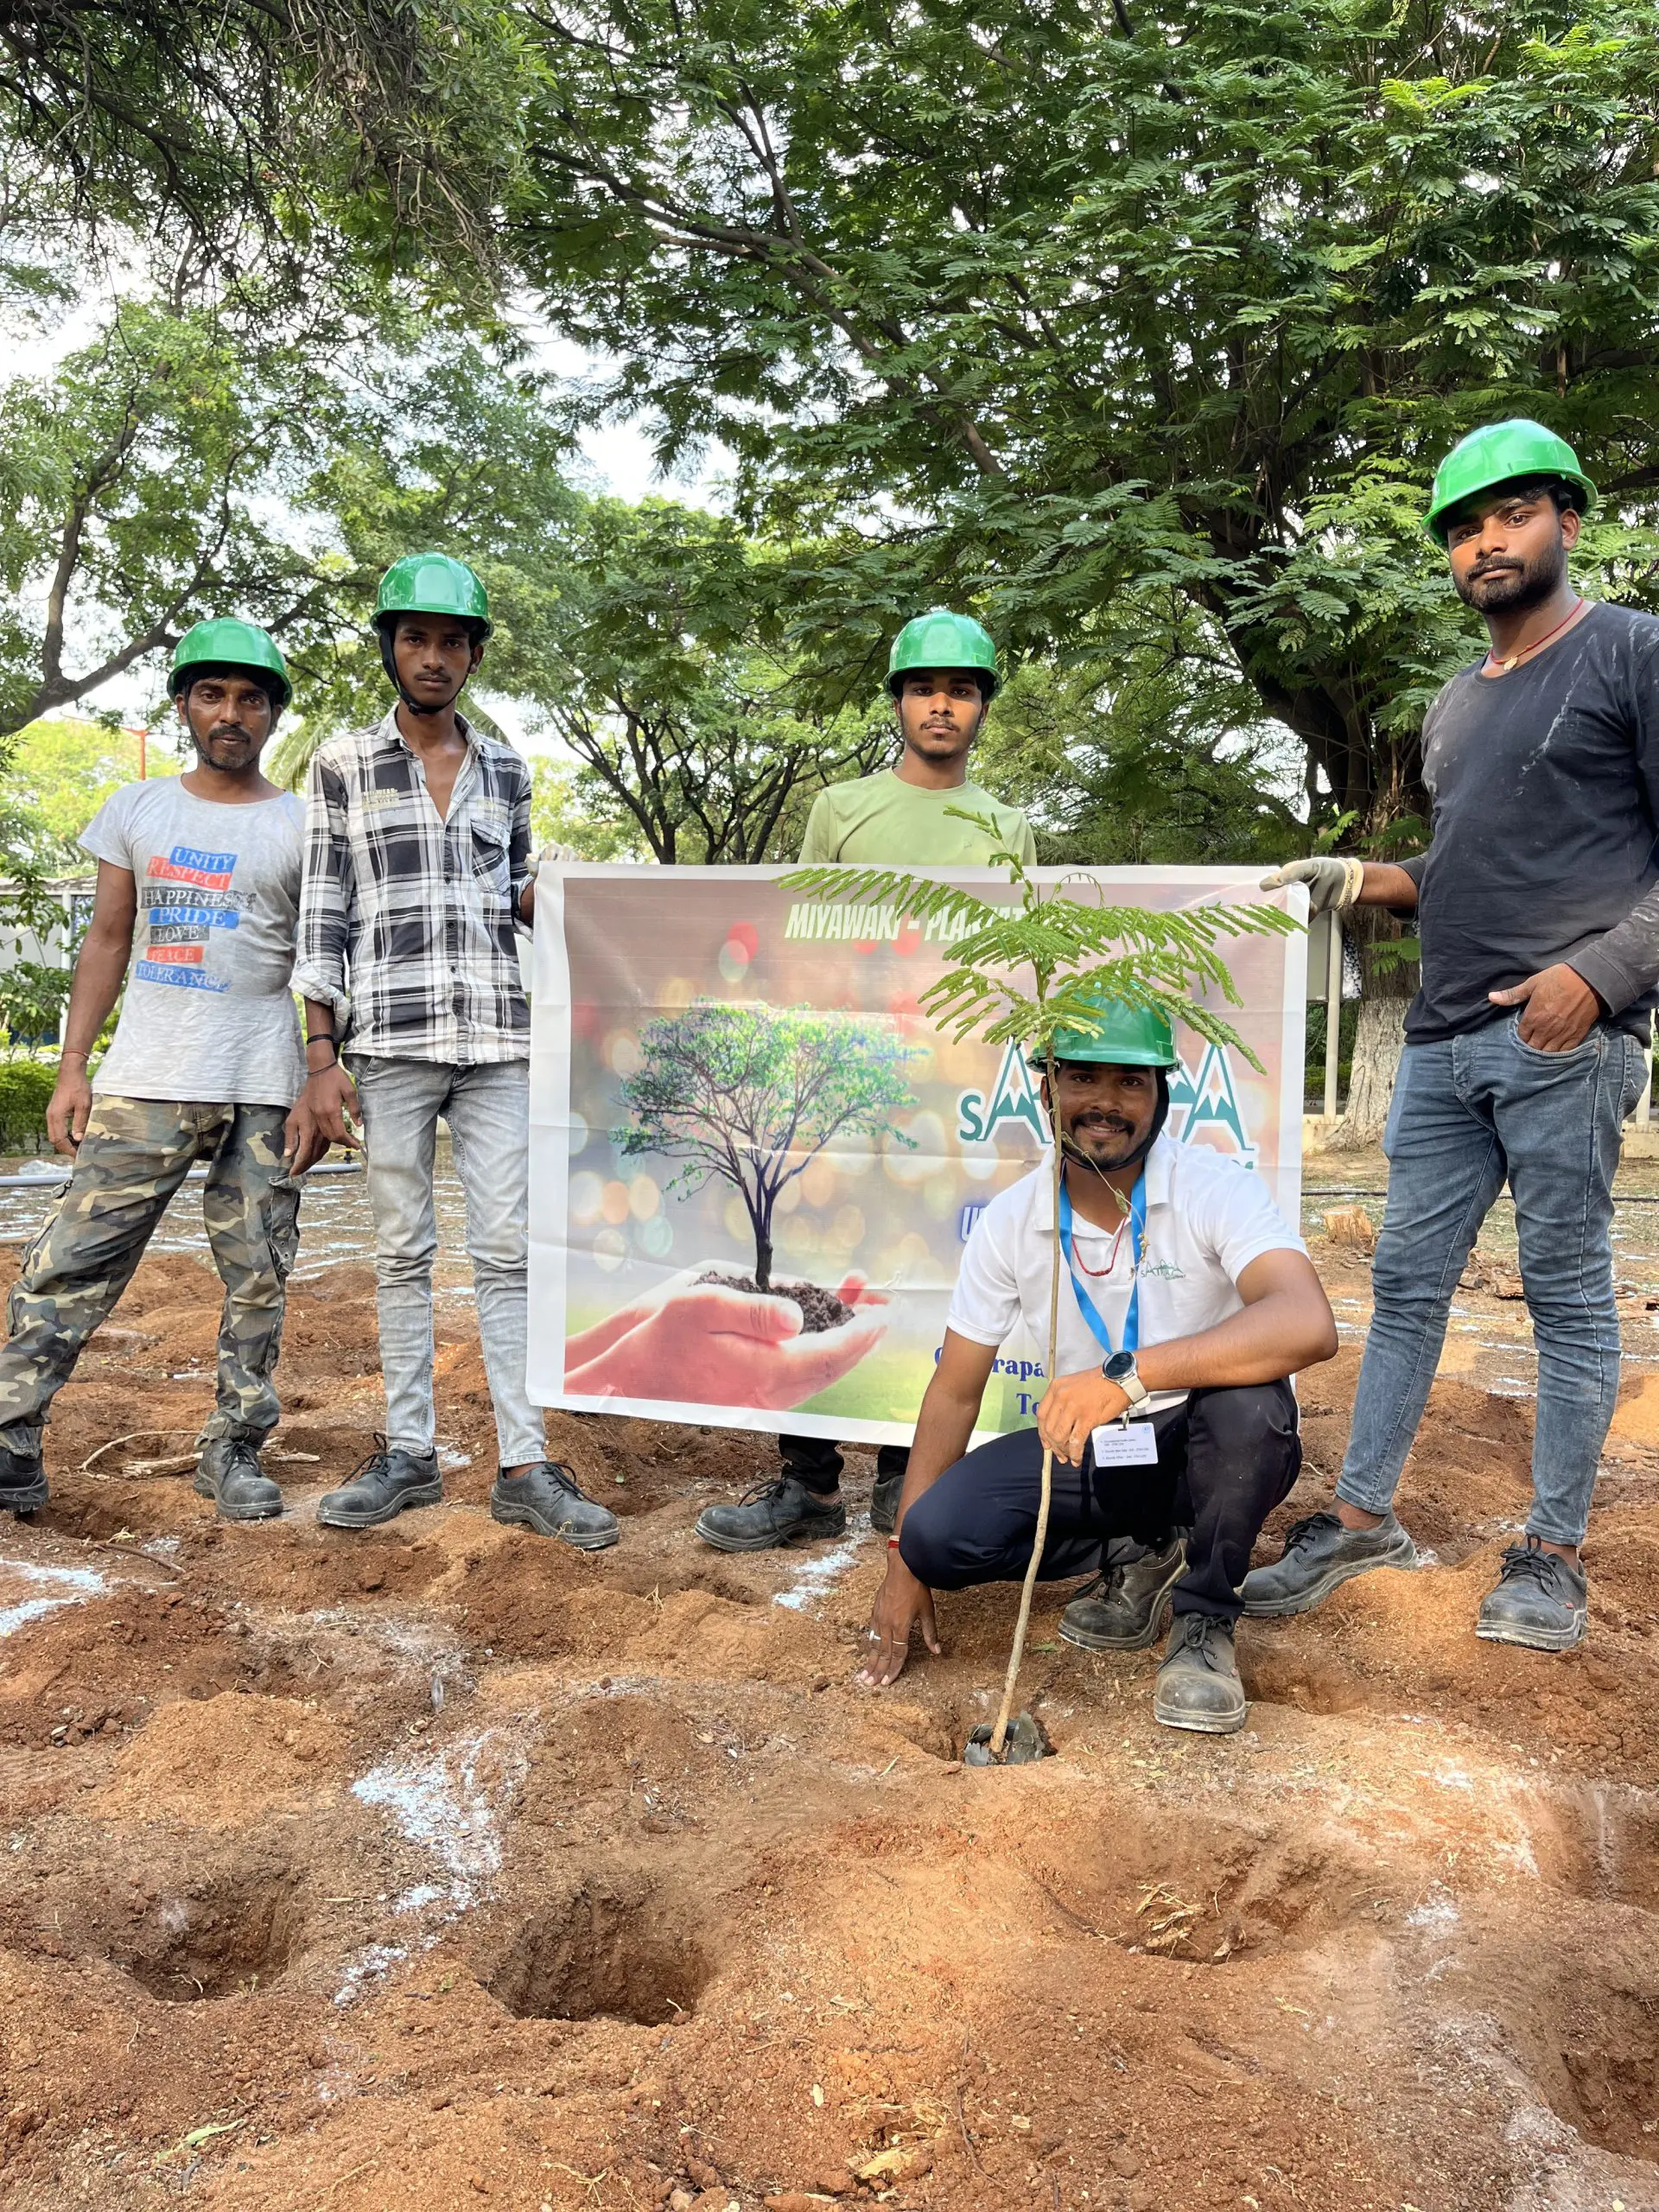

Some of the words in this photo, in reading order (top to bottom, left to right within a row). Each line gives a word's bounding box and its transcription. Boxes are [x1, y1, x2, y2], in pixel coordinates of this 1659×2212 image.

[174, 848, 234, 871] UNITY
[148, 857, 232, 888] RESPECT
[157, 906, 226, 927] PRIDE
[785, 903, 902, 940] MIYAWAKI
[156, 925, 200, 944] LOVE
